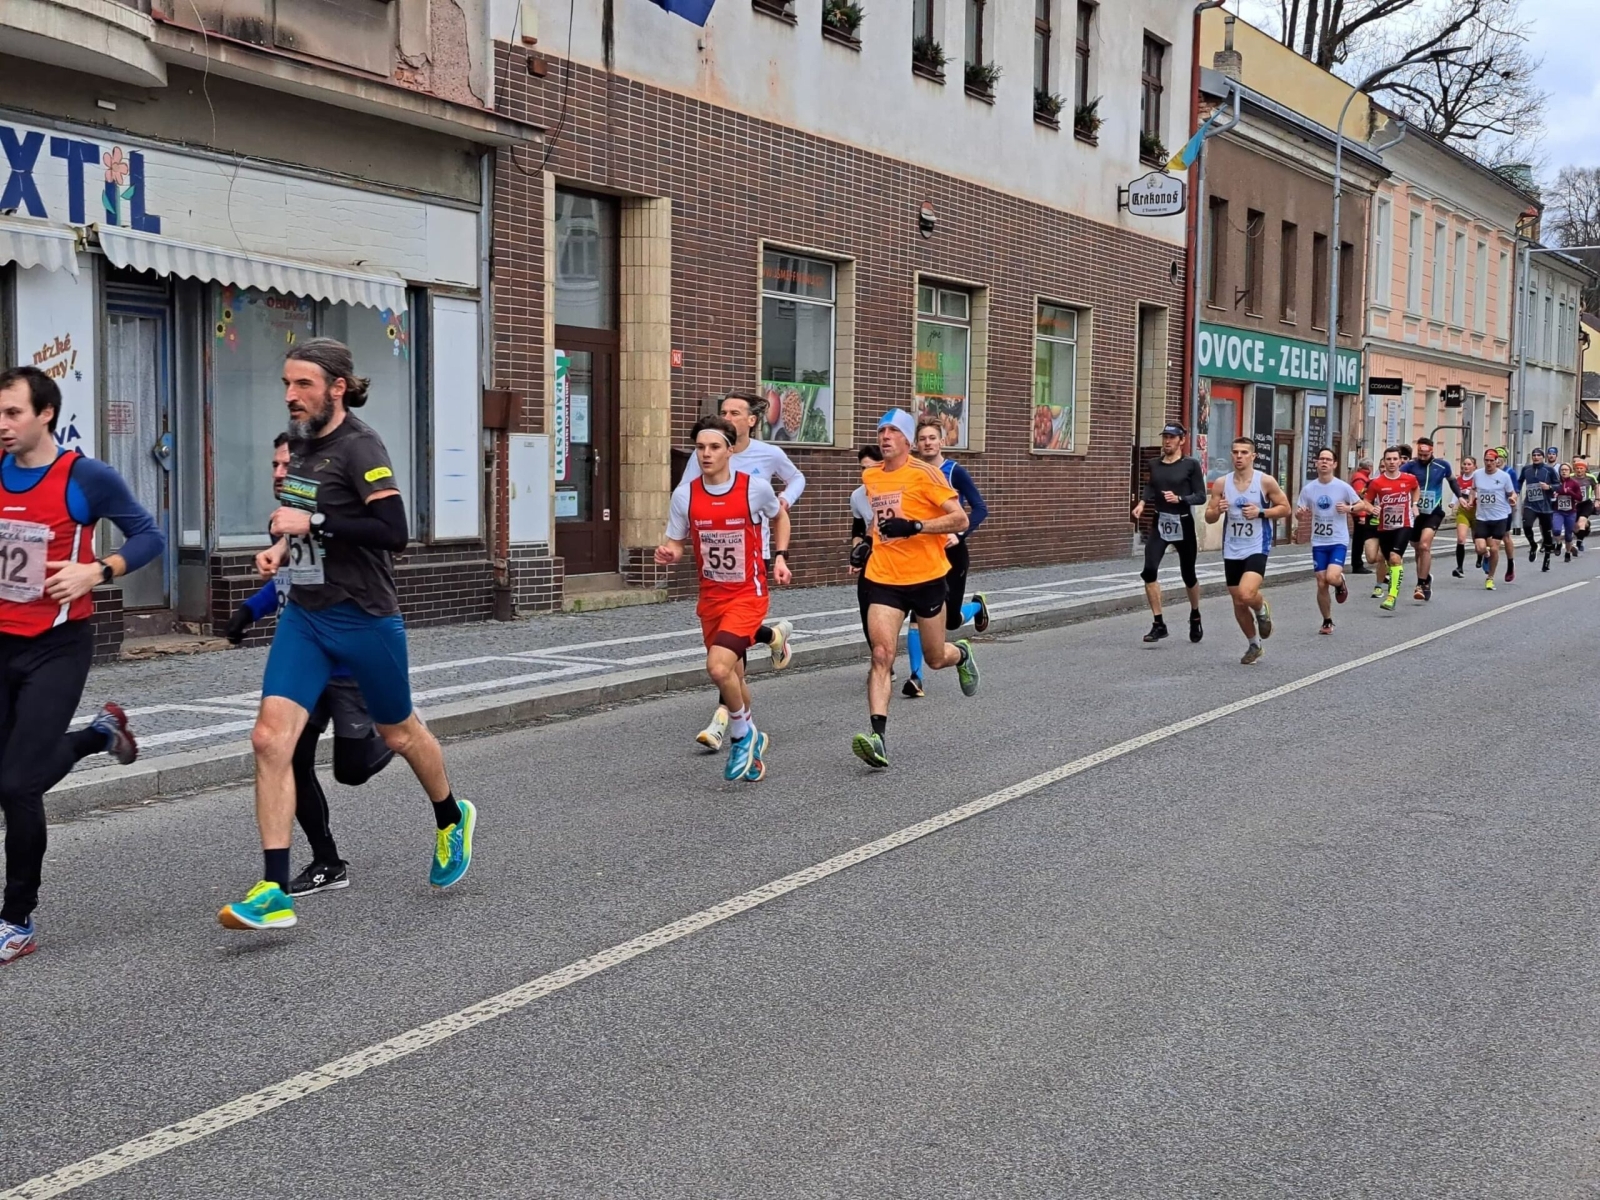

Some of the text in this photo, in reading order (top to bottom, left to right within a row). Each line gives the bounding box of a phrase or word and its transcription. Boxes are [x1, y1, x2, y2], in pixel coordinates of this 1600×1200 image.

[1132, 190, 1179, 206] Krakonoš
[33, 333, 71, 365] nízké
[1198, 331, 1264, 373] OVOCE
[45, 350, 77, 379] eny!
[54, 413, 81, 445] VÁ
[1480, 494, 1496, 504] 293
[1528, 488, 1542, 497] 302
[1417, 498, 1434, 509] 281
[1384, 513, 1403, 525] 244
[1160, 522, 1179, 535] 167
[1231, 523, 1253, 537] 173
[1314, 522, 1333, 536] 225
[708, 546, 736, 571] 55
